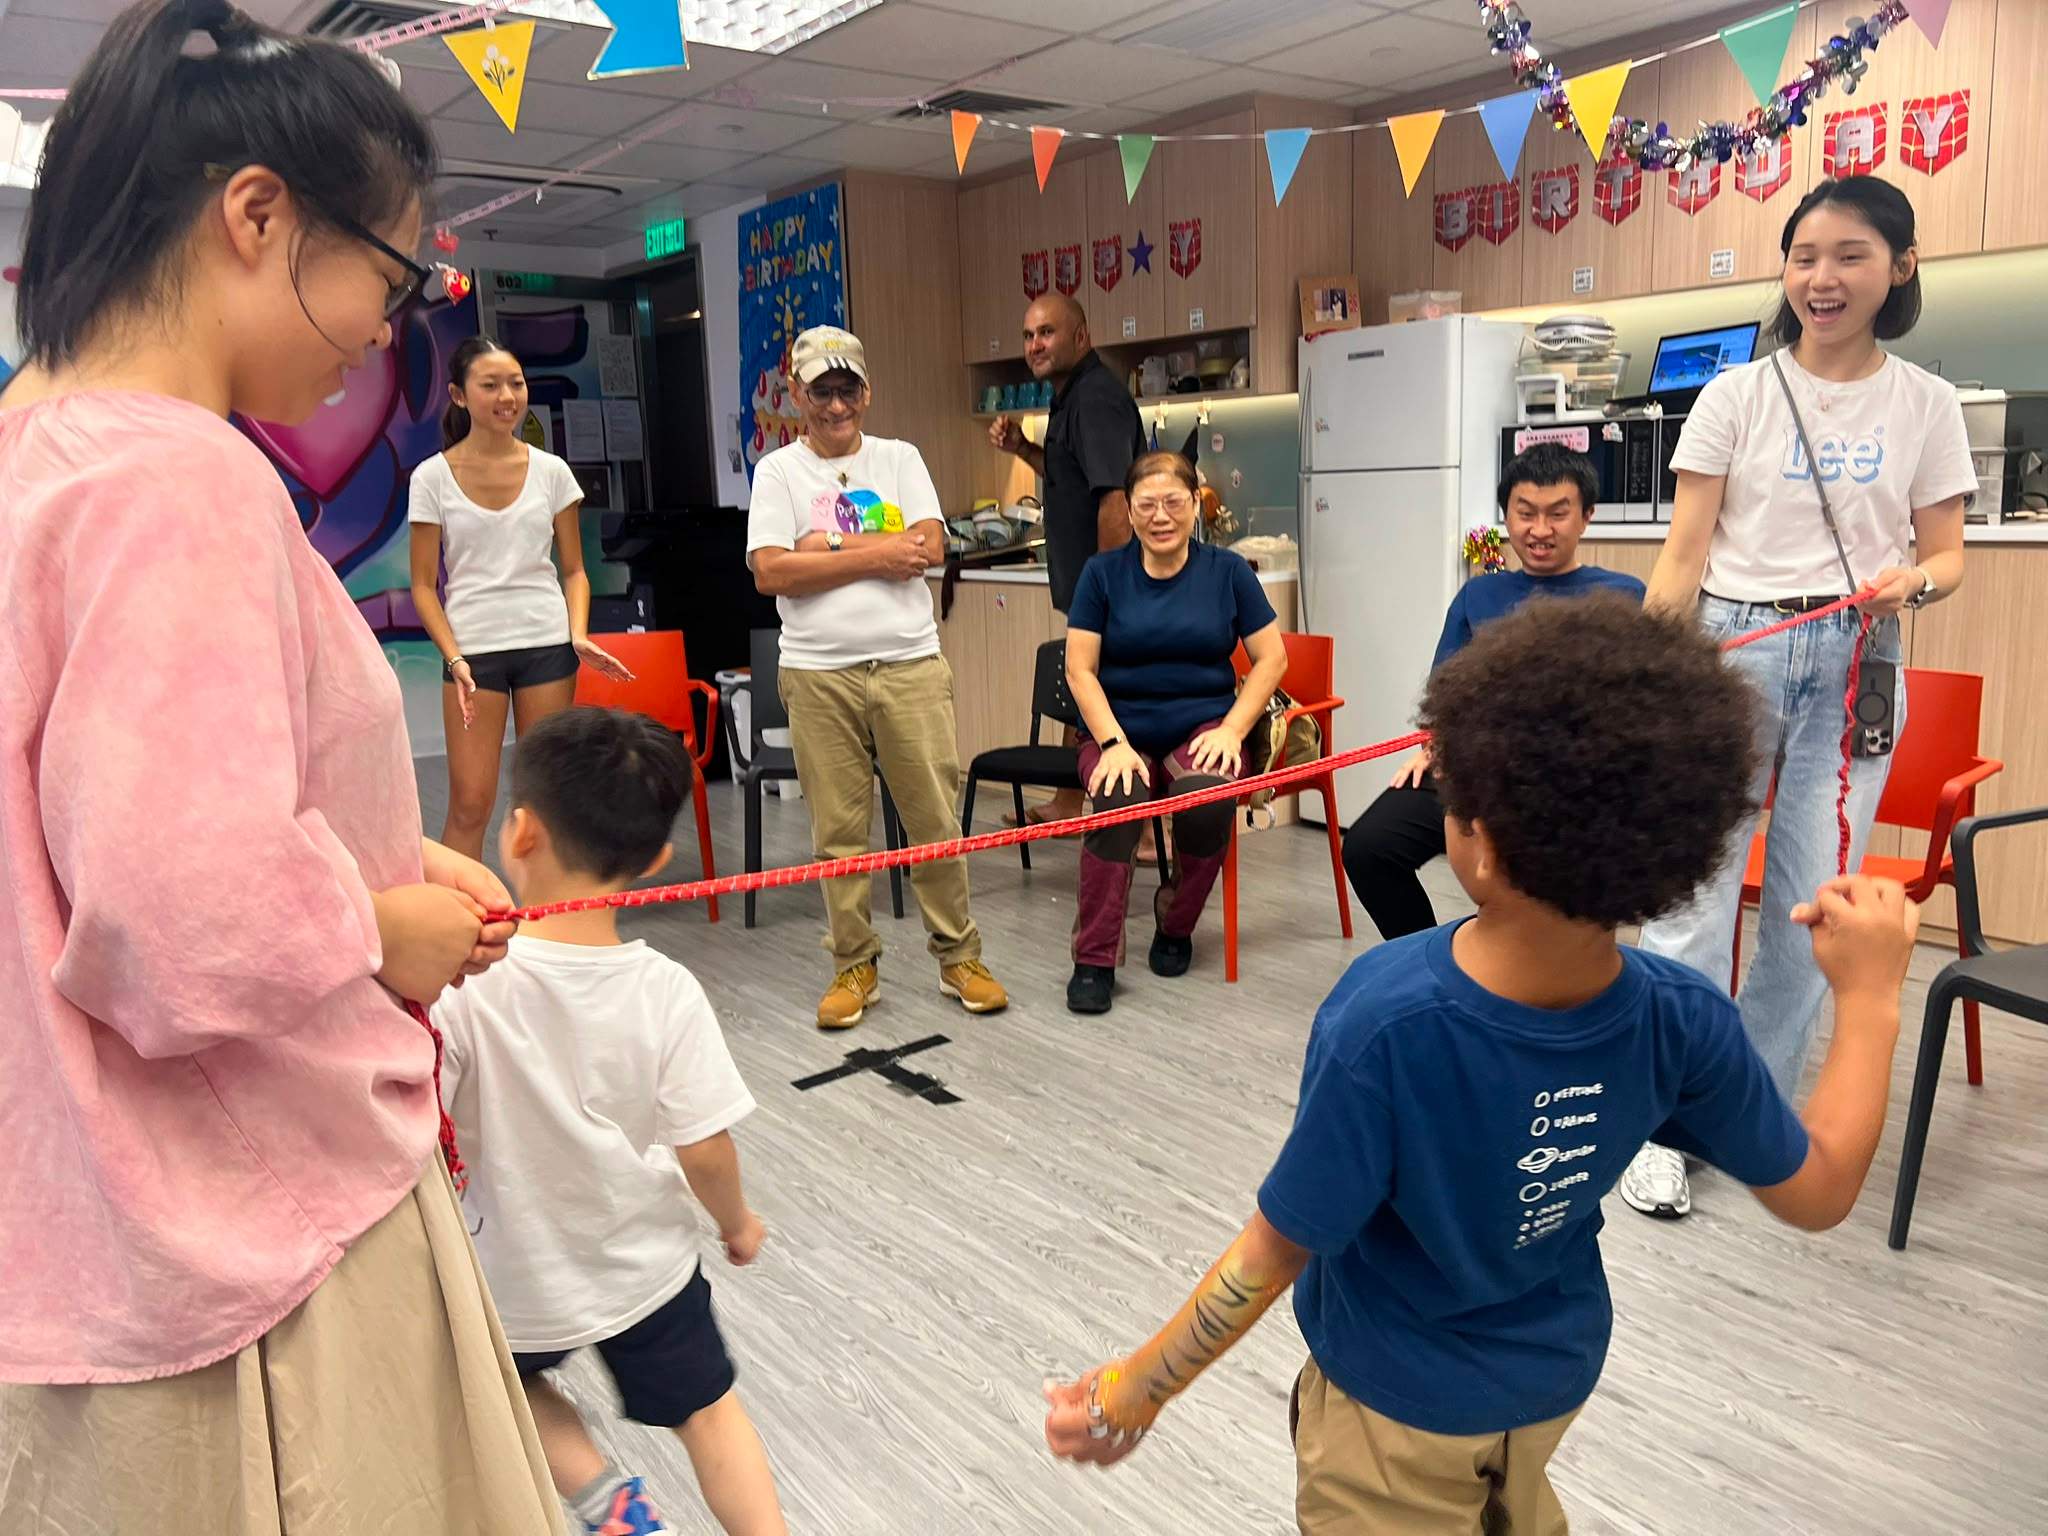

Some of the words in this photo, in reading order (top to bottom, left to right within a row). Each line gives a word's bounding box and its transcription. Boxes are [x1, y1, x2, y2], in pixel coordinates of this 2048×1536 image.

[646, 224, 665, 260] EXIT
[750, 213, 806, 258] HAPPY
[744, 239, 834, 292] BIRTHDAY
[1780, 425, 1884, 484] Lee
